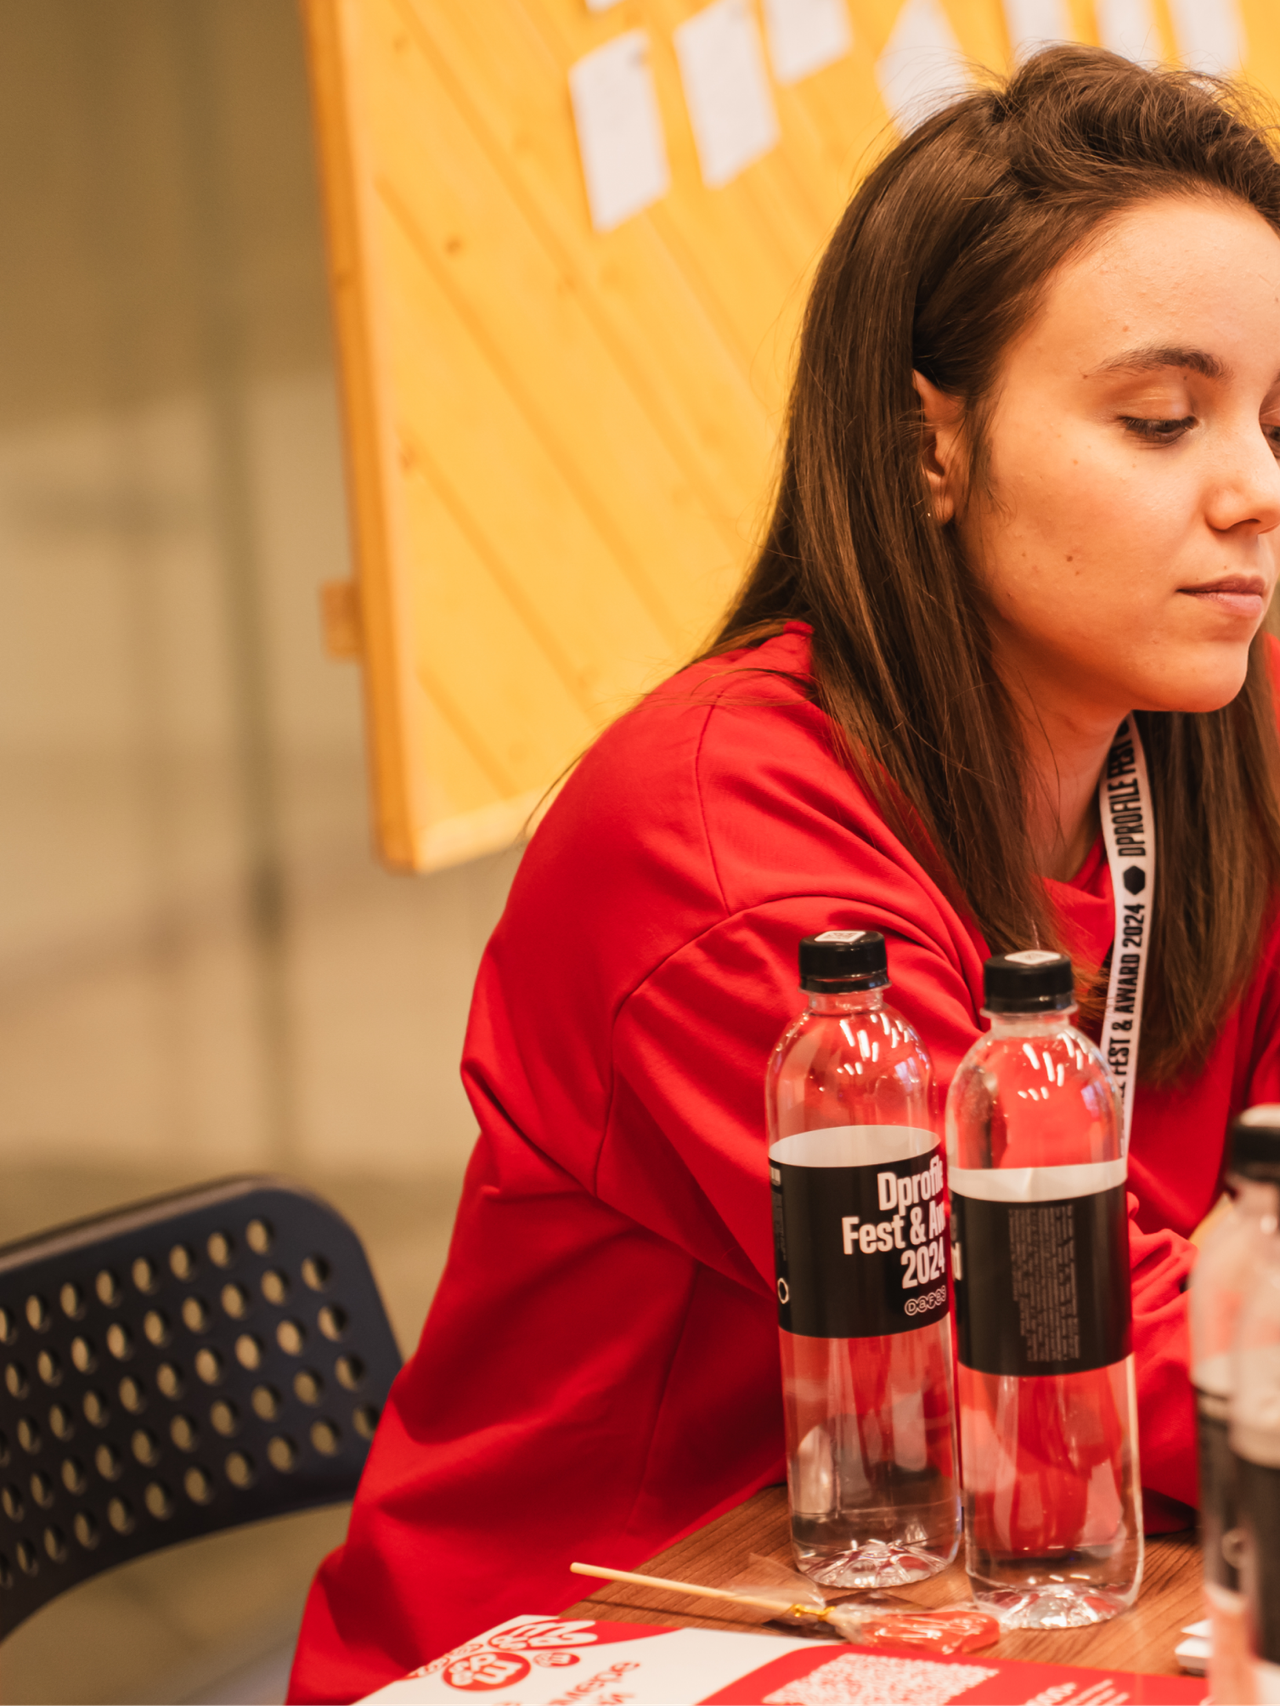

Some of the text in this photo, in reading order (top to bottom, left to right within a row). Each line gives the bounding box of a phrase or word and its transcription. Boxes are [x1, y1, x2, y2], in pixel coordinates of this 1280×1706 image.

[1108, 777, 1147, 857] DPROFILE
[1123, 903, 1146, 948] 2024
[1114, 953, 1141, 1015] AWARD
[1111, 1018, 1133, 1032] &
[841, 1214, 906, 1255] Fest
[909, 1206, 926, 1245] &
[900, 1236, 946, 1289] 2024
